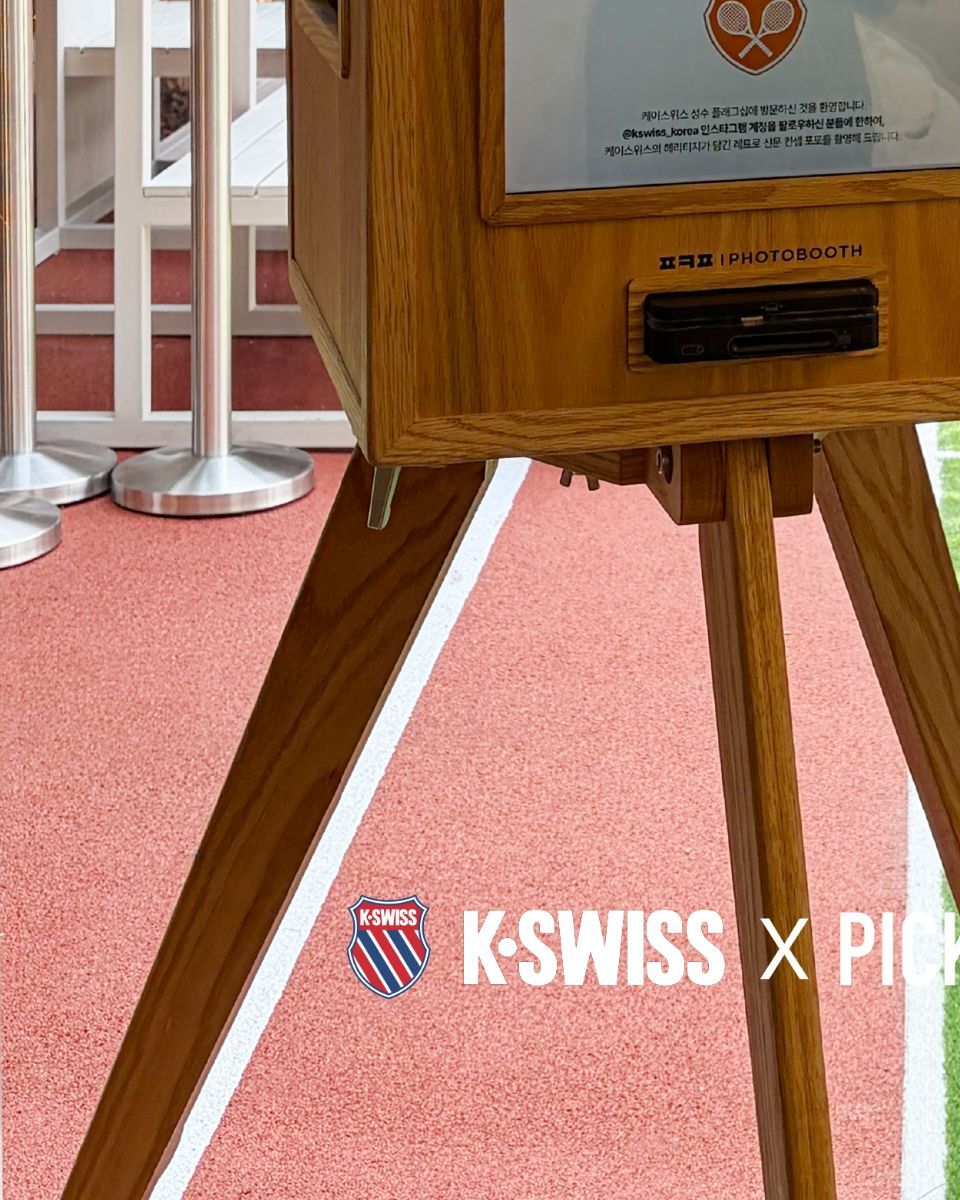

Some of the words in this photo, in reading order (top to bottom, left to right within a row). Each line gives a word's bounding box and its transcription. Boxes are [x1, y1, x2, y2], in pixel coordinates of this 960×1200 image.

[640, 108, 690, 122] 케이스위스
[690, 107, 710, 120] 성수
[711, 104, 758, 119] 플래그십에
[759, 103, 797, 116] 방문하신
[798, 101, 817, 114] 것을
[622, 126, 699, 140] @kswiss_korea
[700, 121, 748, 136] 인스타그램
[748, 120, 776, 133] 계정을
[854, 116, 884, 128] 한하여,
[604, 142, 662, 158] 케이스위스의
[663, 140, 711, 154] 헤리티지가
[732, 137, 761, 151] 레트로
[763, 136, 782, 149] 신문
[784, 135, 803, 148] 컨셉
[729, 244, 863, 266] PHOTOBOOTH
